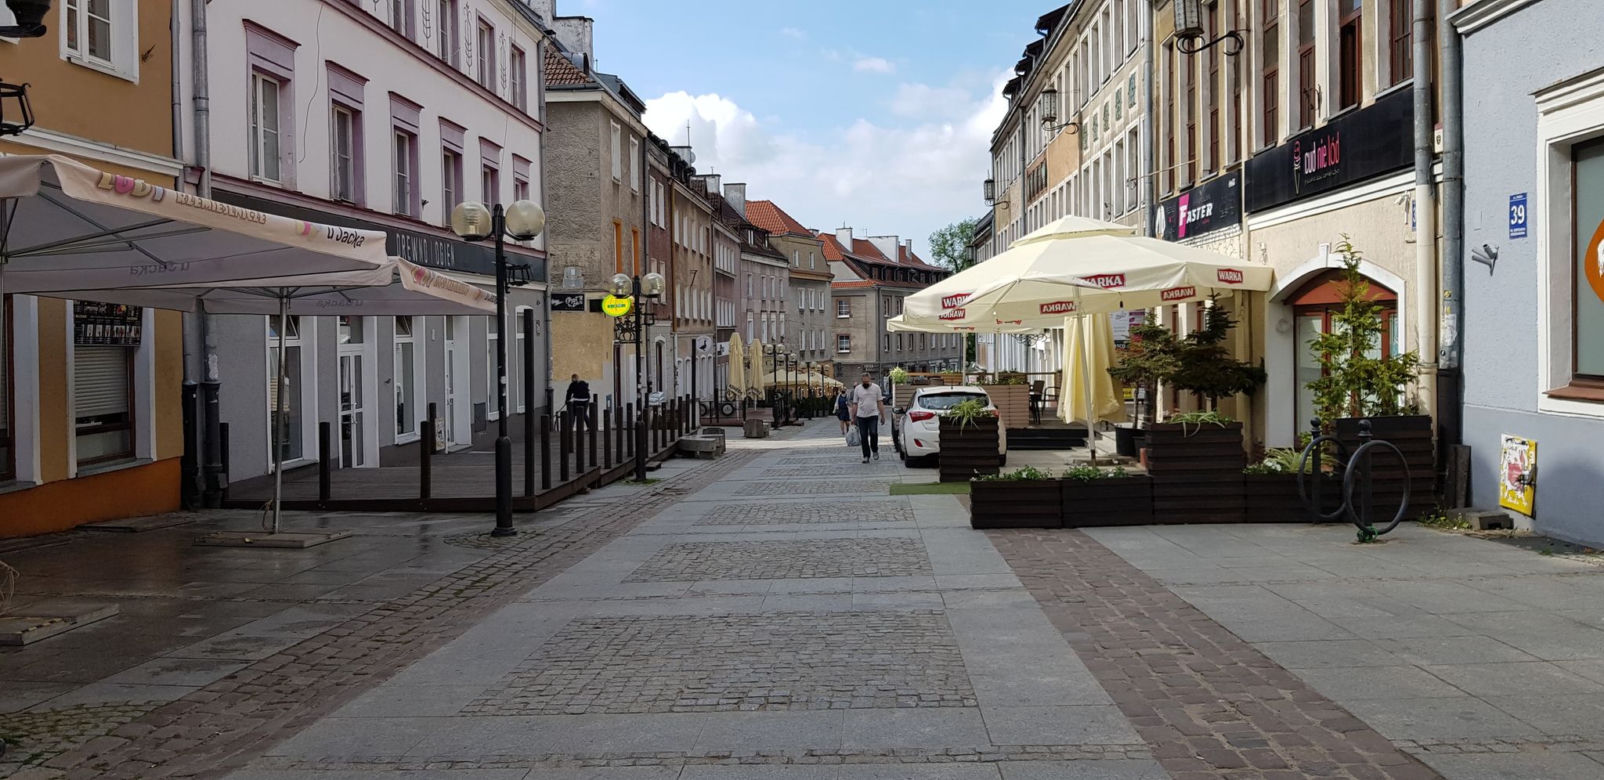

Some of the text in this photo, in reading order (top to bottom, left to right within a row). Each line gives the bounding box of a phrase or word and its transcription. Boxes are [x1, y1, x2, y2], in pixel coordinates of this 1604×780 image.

[1305, 141, 1316, 174] cud
[1317, 138, 1327, 169] nie
[1511, 204, 1525, 225] 39
[327, 226, 365, 248] u Jacka
[396, 233, 428, 263] DREWNO
[1086, 275, 1123, 287] ARKA
[1218, 270, 1242, 282] WARKA
